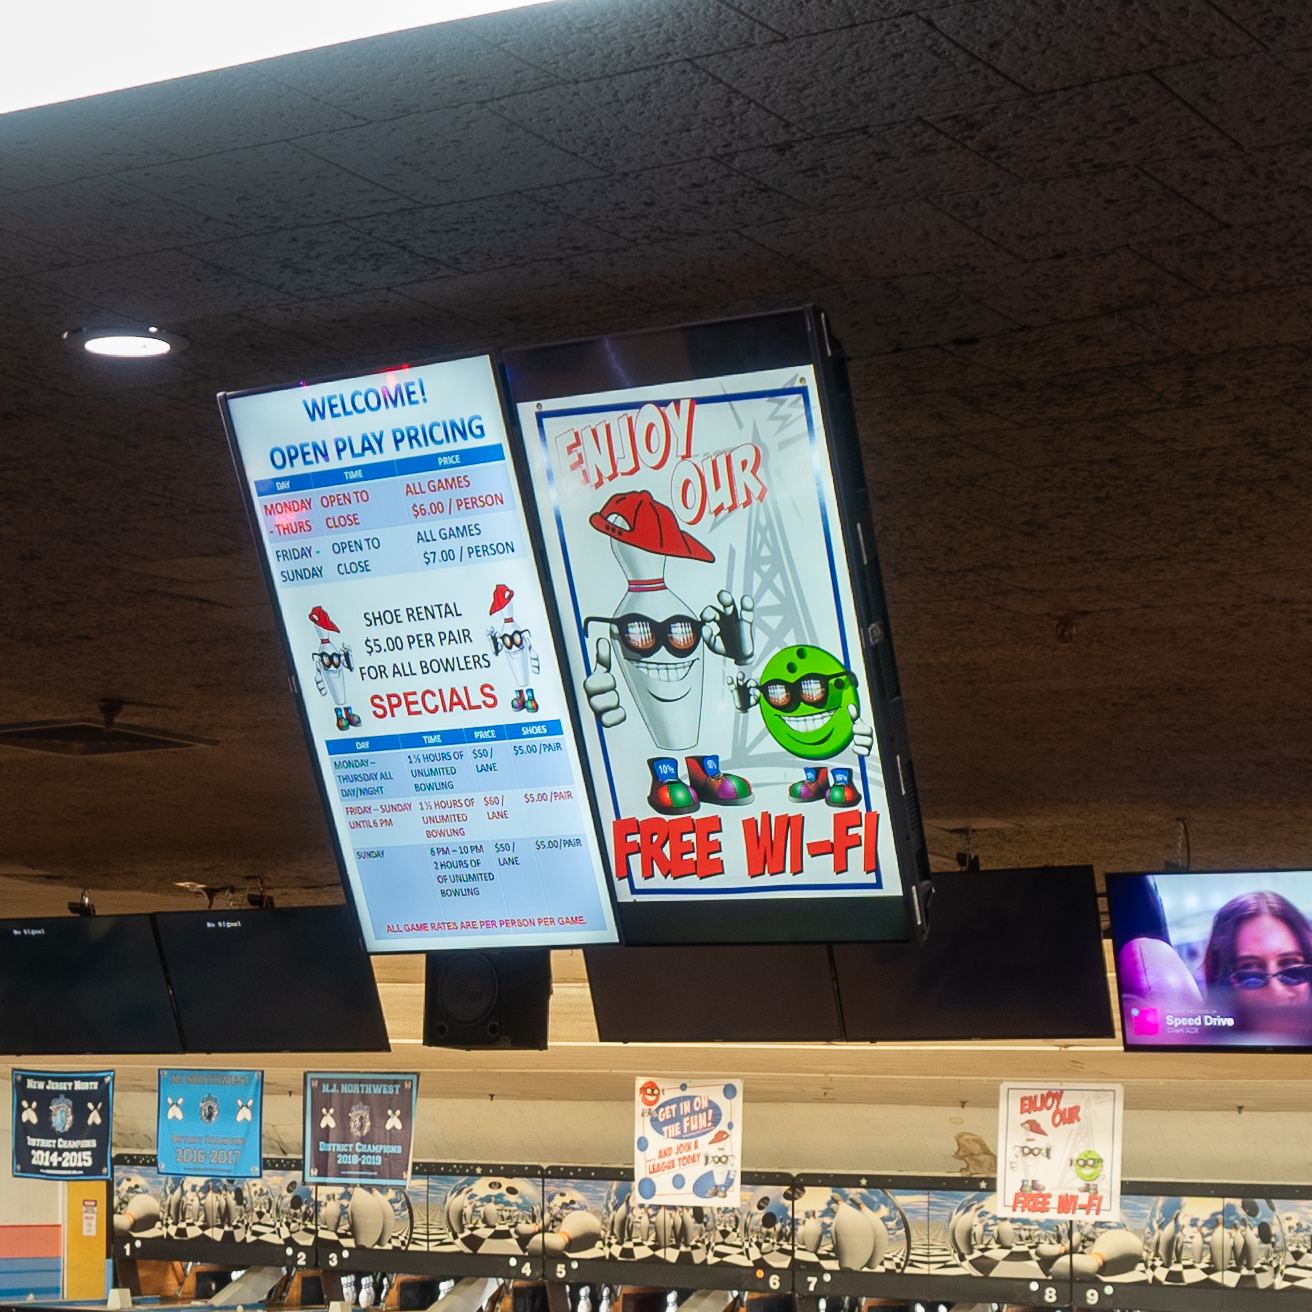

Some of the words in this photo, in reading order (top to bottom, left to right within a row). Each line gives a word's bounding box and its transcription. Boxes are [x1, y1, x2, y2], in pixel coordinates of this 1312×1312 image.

[303, 378, 427, 421] WELCOME!
[270, 443, 330, 470] OPEN
[335, 430, 384, 460] PLAY
[393, 415, 485, 451] PRICING
[555, 399, 696, 489] ENJOY
[405, 482, 425, 496] ALL
[427, 475, 470, 494] GAMES
[670, 443, 768, 526] OUR
[264, 498, 312, 517] MONDAY
[281, 566, 323, 584] SUNDAY
[364, 609, 402, 627] SHOE
[407, 602, 462, 622] RENTAL
[365, 636, 403, 655] $5.00
[408, 633, 435, 648] PER
[440, 628, 472, 645] PAIR
[360, 666, 388, 681] FOR
[392, 662, 417, 678] ALL
[421, 654, 491, 674] BOWLERS
[370, 684, 498, 719] SPECIALS
[411, 767, 456, 778] UNLIMITED
[612, 814, 725, 880] FREE
[742, 809, 880, 879] WI-FI
[658, 1104, 677, 1122] GET
[680, 1100, 691, 1115] IN
[693, 1095, 709, 1111] ON
[1020, 1089, 1064, 1114] ENJOY
[662, 1122, 681, 1139] THE
[683, 1109, 714, 1137] FUN!
[1052, 1105, 1081, 1128] OUR
[31, 1150, 92, 1167] 2014-2015
[176, 1148, 241, 1164] 2016-2017
[1012, 1192, 1052, 1213] FREE
[1058, 1194, 1103, 1215] WI-FI
[296, 1251, 306, 1265] 2
[806, 1276, 817, 1291] 7
